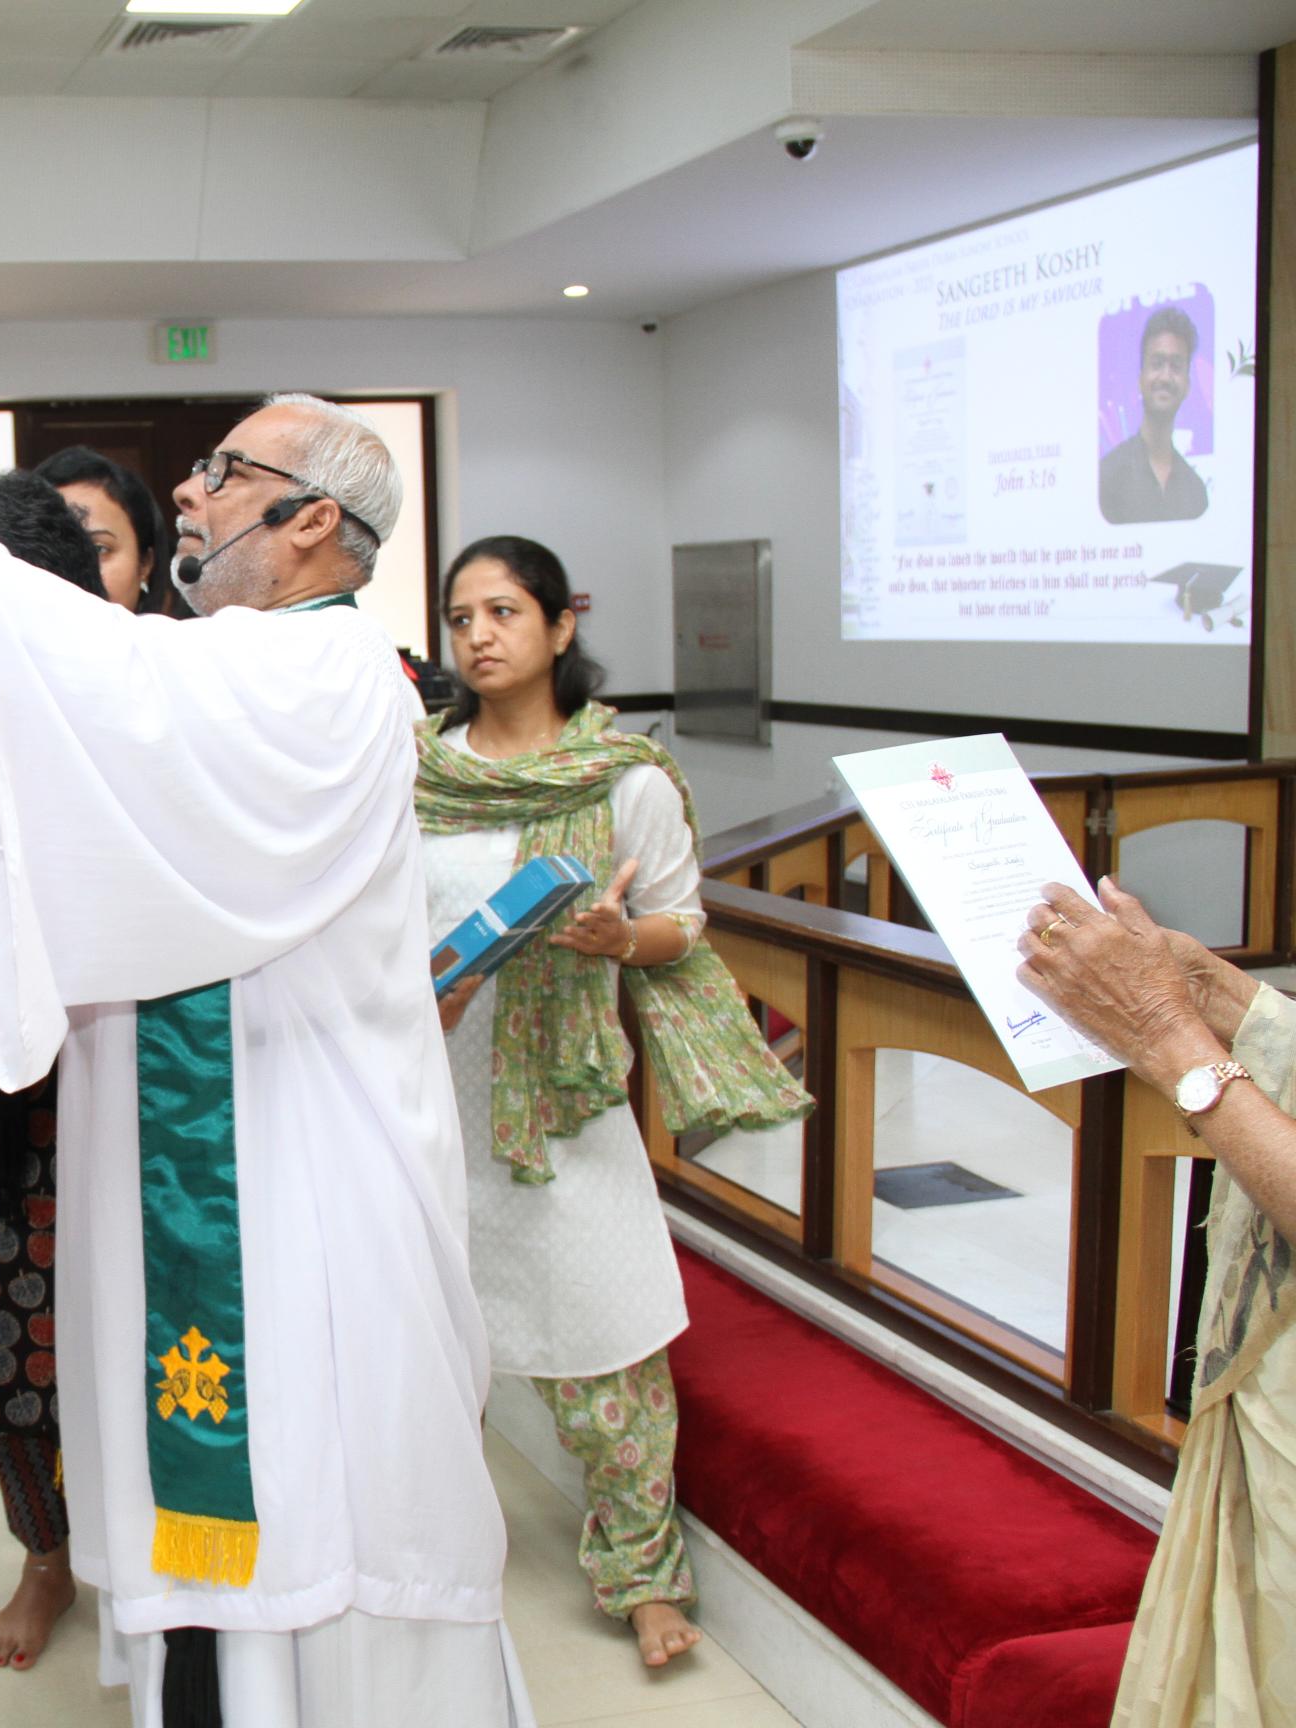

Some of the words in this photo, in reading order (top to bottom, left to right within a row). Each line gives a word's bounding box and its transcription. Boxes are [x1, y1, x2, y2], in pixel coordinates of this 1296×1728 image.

[936, 261, 1027, 307] SANGEETH
[1036, 240, 1104, 281] KOSHY
[938, 310, 961, 331] THE
[964, 302, 1000, 326] LORD
[1003, 297, 1015, 316] IS
[1019, 292, 1039, 312] MY
[1041, 277, 1103, 307] SAVIOUR
[168, 326, 208, 361] EXIT
[992, 467, 1024, 498] John
[1027, 466, 1056, 489] 3:16
[909, 811, 964, 847] Certificate
